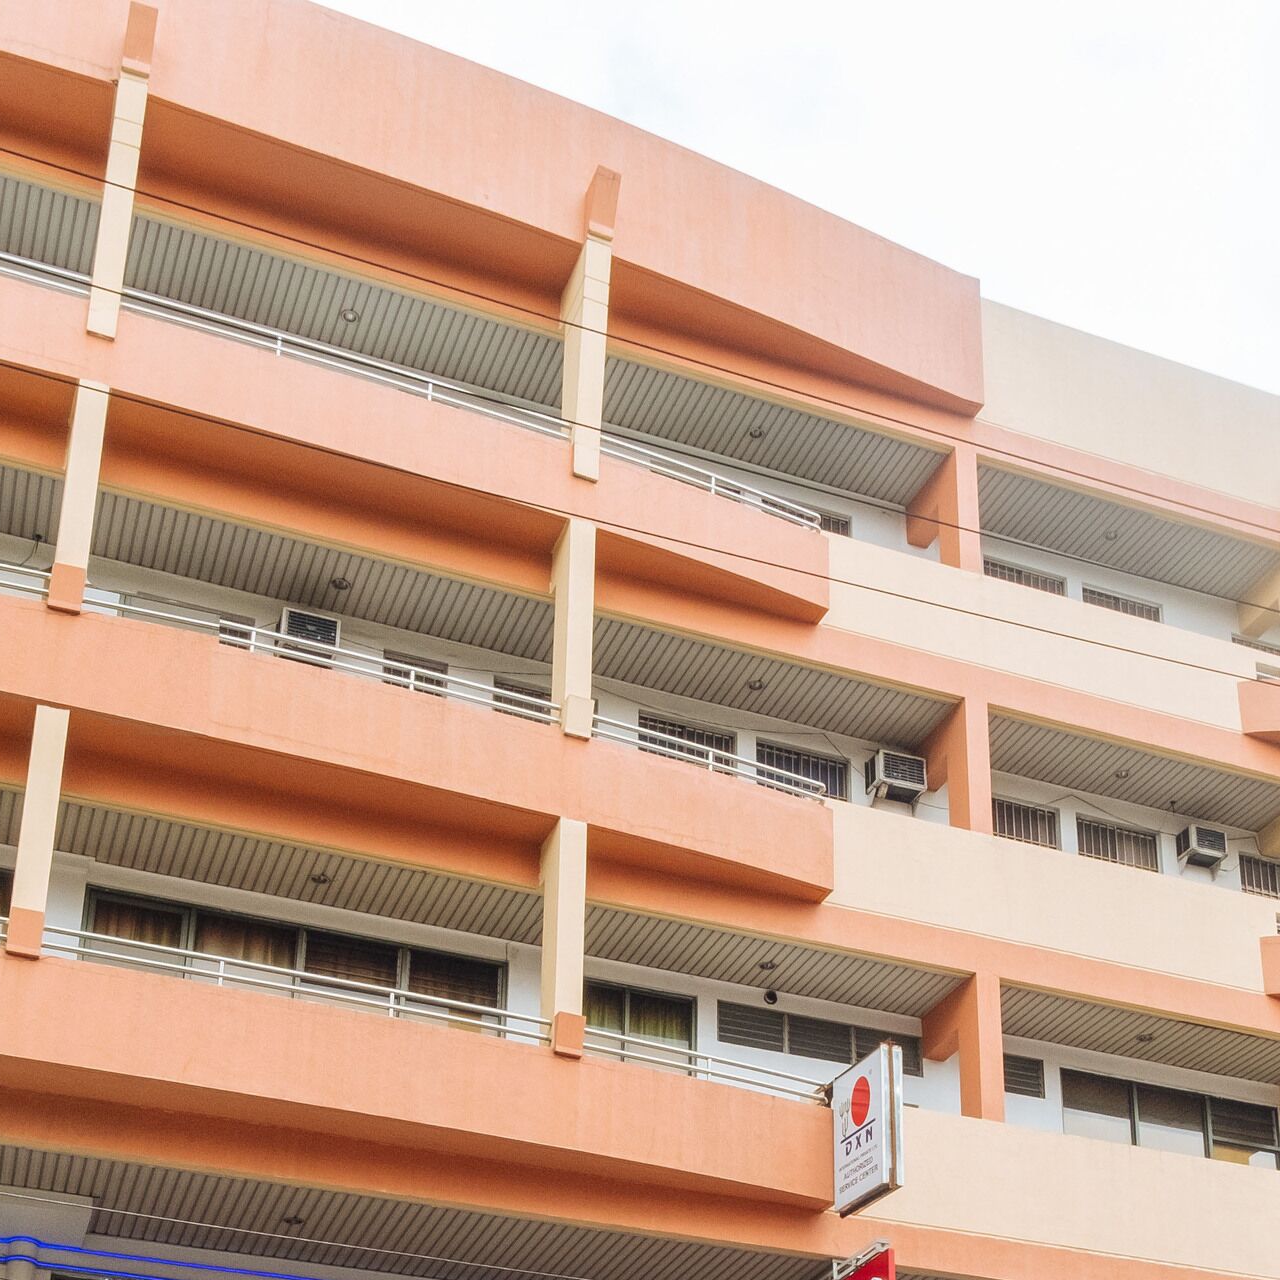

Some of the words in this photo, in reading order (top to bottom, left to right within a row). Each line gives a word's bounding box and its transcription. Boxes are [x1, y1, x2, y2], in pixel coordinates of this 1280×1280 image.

[845, 1126, 874, 1156] DXN
[839, 1177, 858, 1195] SERVICE
[859, 1163, 879, 1183] CENTER
